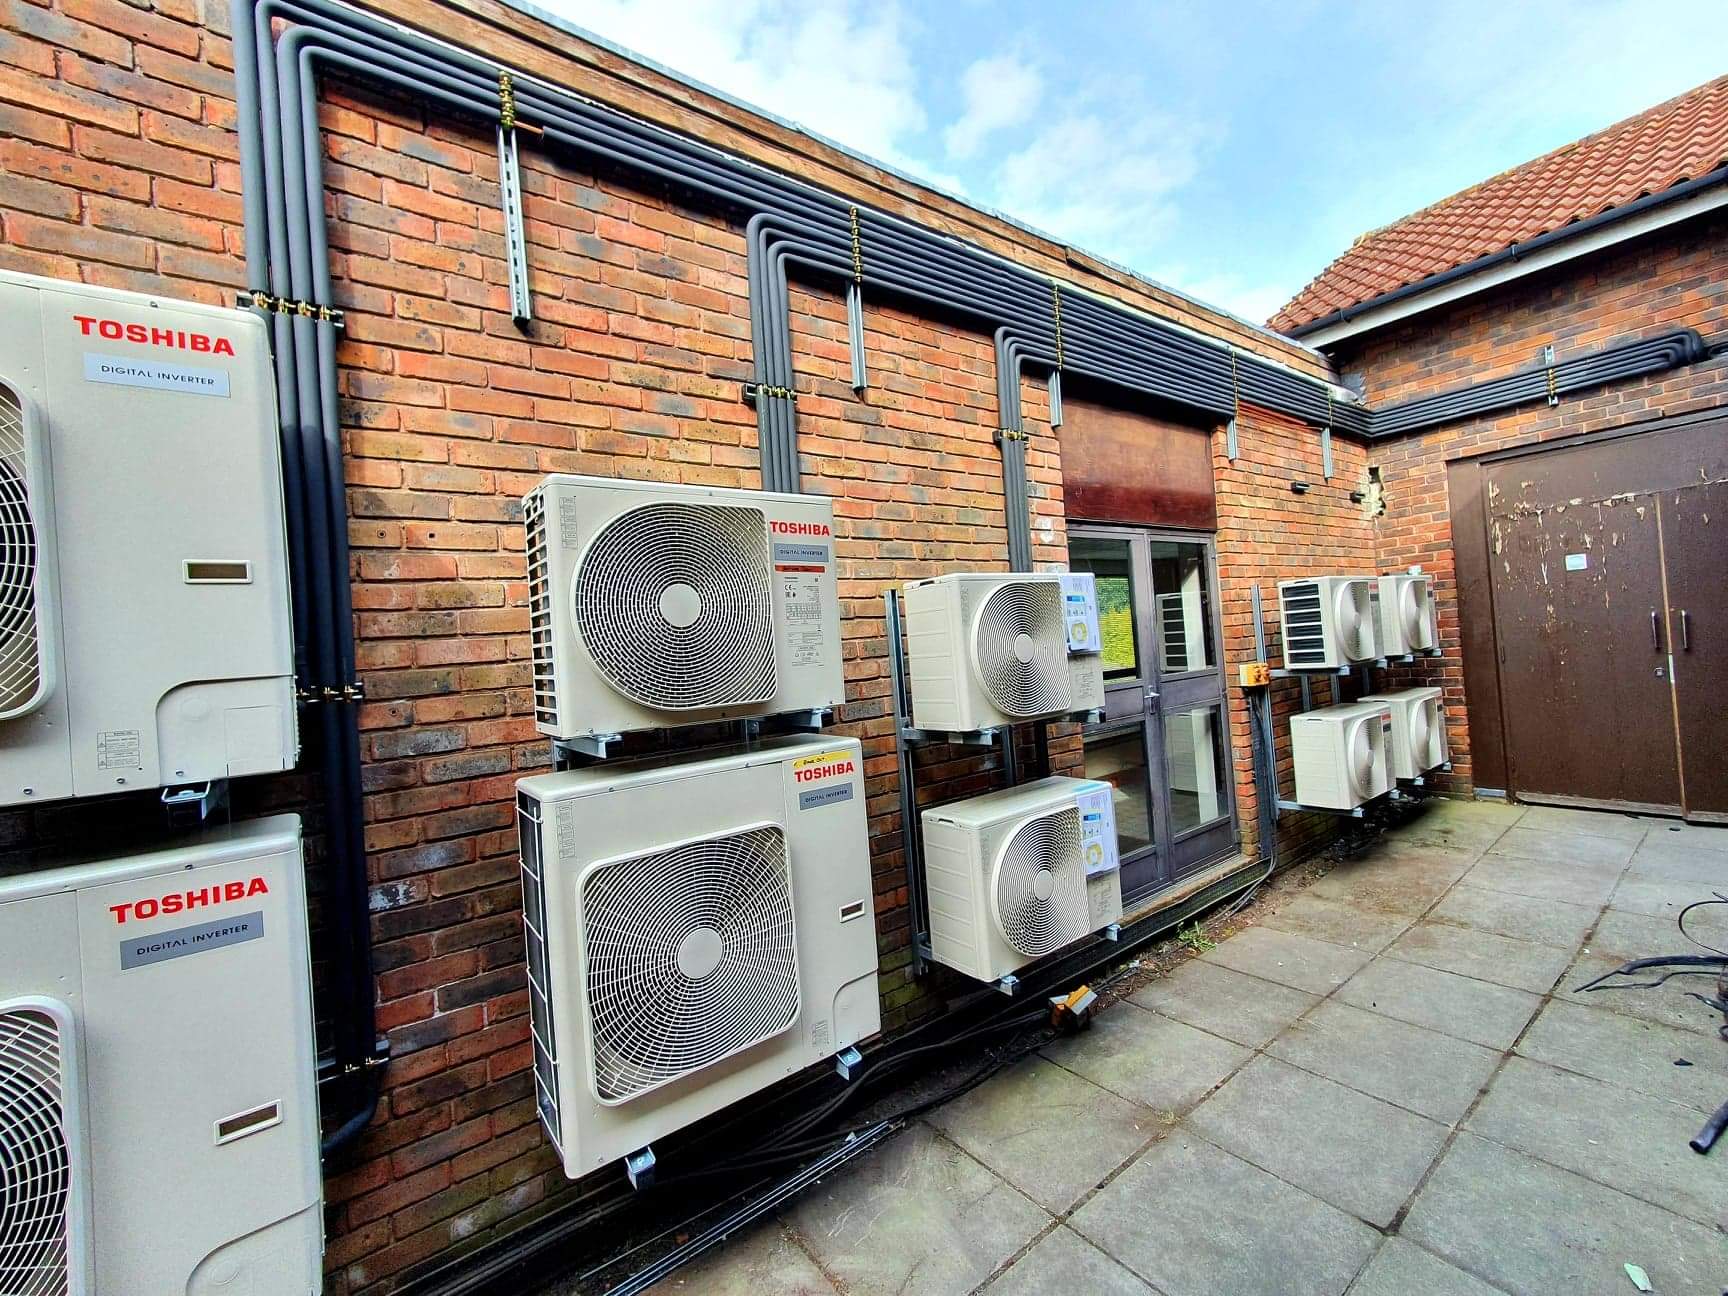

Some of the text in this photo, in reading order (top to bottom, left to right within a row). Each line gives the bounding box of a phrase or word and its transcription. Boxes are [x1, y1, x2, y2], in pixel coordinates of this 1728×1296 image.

[73, 315, 235, 357] TOSHIBA
[101, 365, 215, 386] DIGITAL INVERTER
[769, 521, 830, 537] TOSHIBA
[794, 761, 854, 783] TOSHIBA
[805, 789, 848, 804] DIGITAL INVERTER
[109, 877, 269, 924] TOSHIBA
[136, 924, 249, 956] DIGITAL INVERTER
